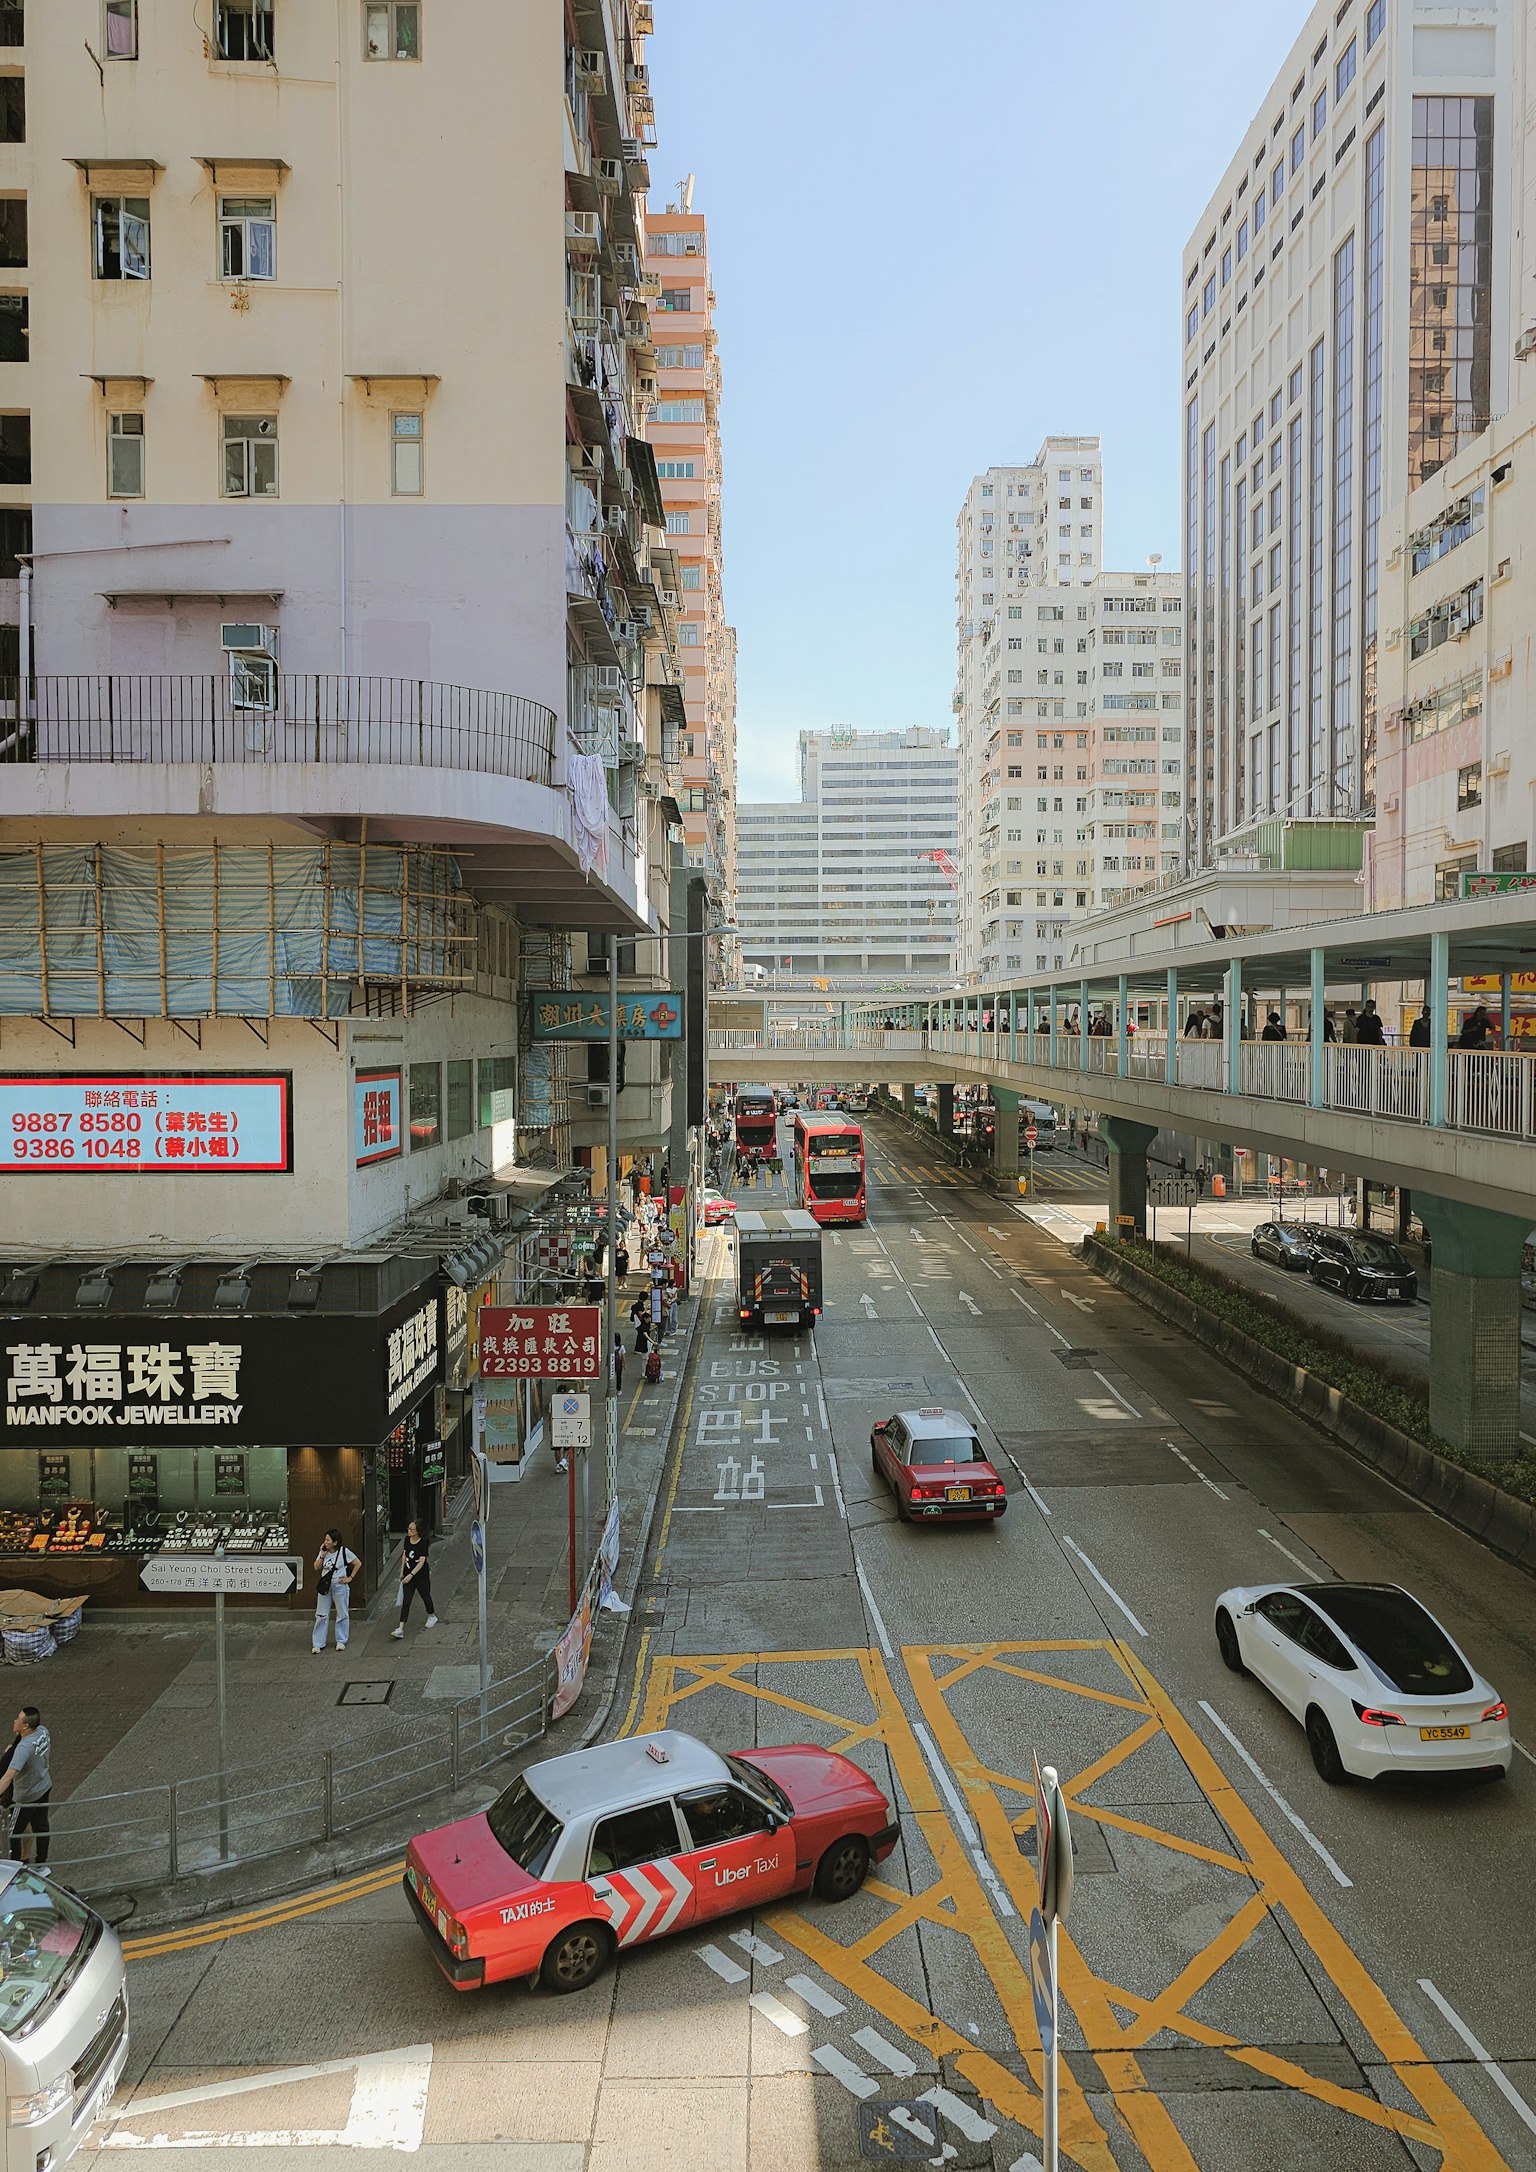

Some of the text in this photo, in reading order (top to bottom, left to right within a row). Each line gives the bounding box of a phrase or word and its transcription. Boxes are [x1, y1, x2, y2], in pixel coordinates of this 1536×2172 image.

[11, 1112, 73, 1132] 9887
[79, 1112, 142, 1132] 8580
[363, 1090, 392, 1147] 招租
[13, 1137, 75, 1158] 9386
[81, 1137, 141, 1158] 1048
[387, 1298, 438, 1393] 萬福珠寶
[6, 1341, 242, 1403] 萬福珠寶
[494, 1357, 542, 1373] 2393
[547, 1357, 595, 1373] 8819
[710, 1360, 781, 1378] BUS
[698, 1382, 790, 1402] STOP
[6, 1405, 243, 1426] MANFOOK JEWELLERY
[577, 1421, 583, 1430] 7
[695, 1408, 788, 1446] 巴士
[577, 1434, 588, 1444] 12
[713, 1455, 765, 1500] 站
[151, 1564, 166, 1573] Sai
[169, 1565, 197, 1574] Yeung
[200, 1565, 221, 1573] Choi
[224, 1565, 253, 1574] Street
[1426, 1727, 1465, 1738] YC 5549
[714, 1853, 779, 1887] Uber Taxi
[500, 1897, 556, 1924] TAXI 的士
